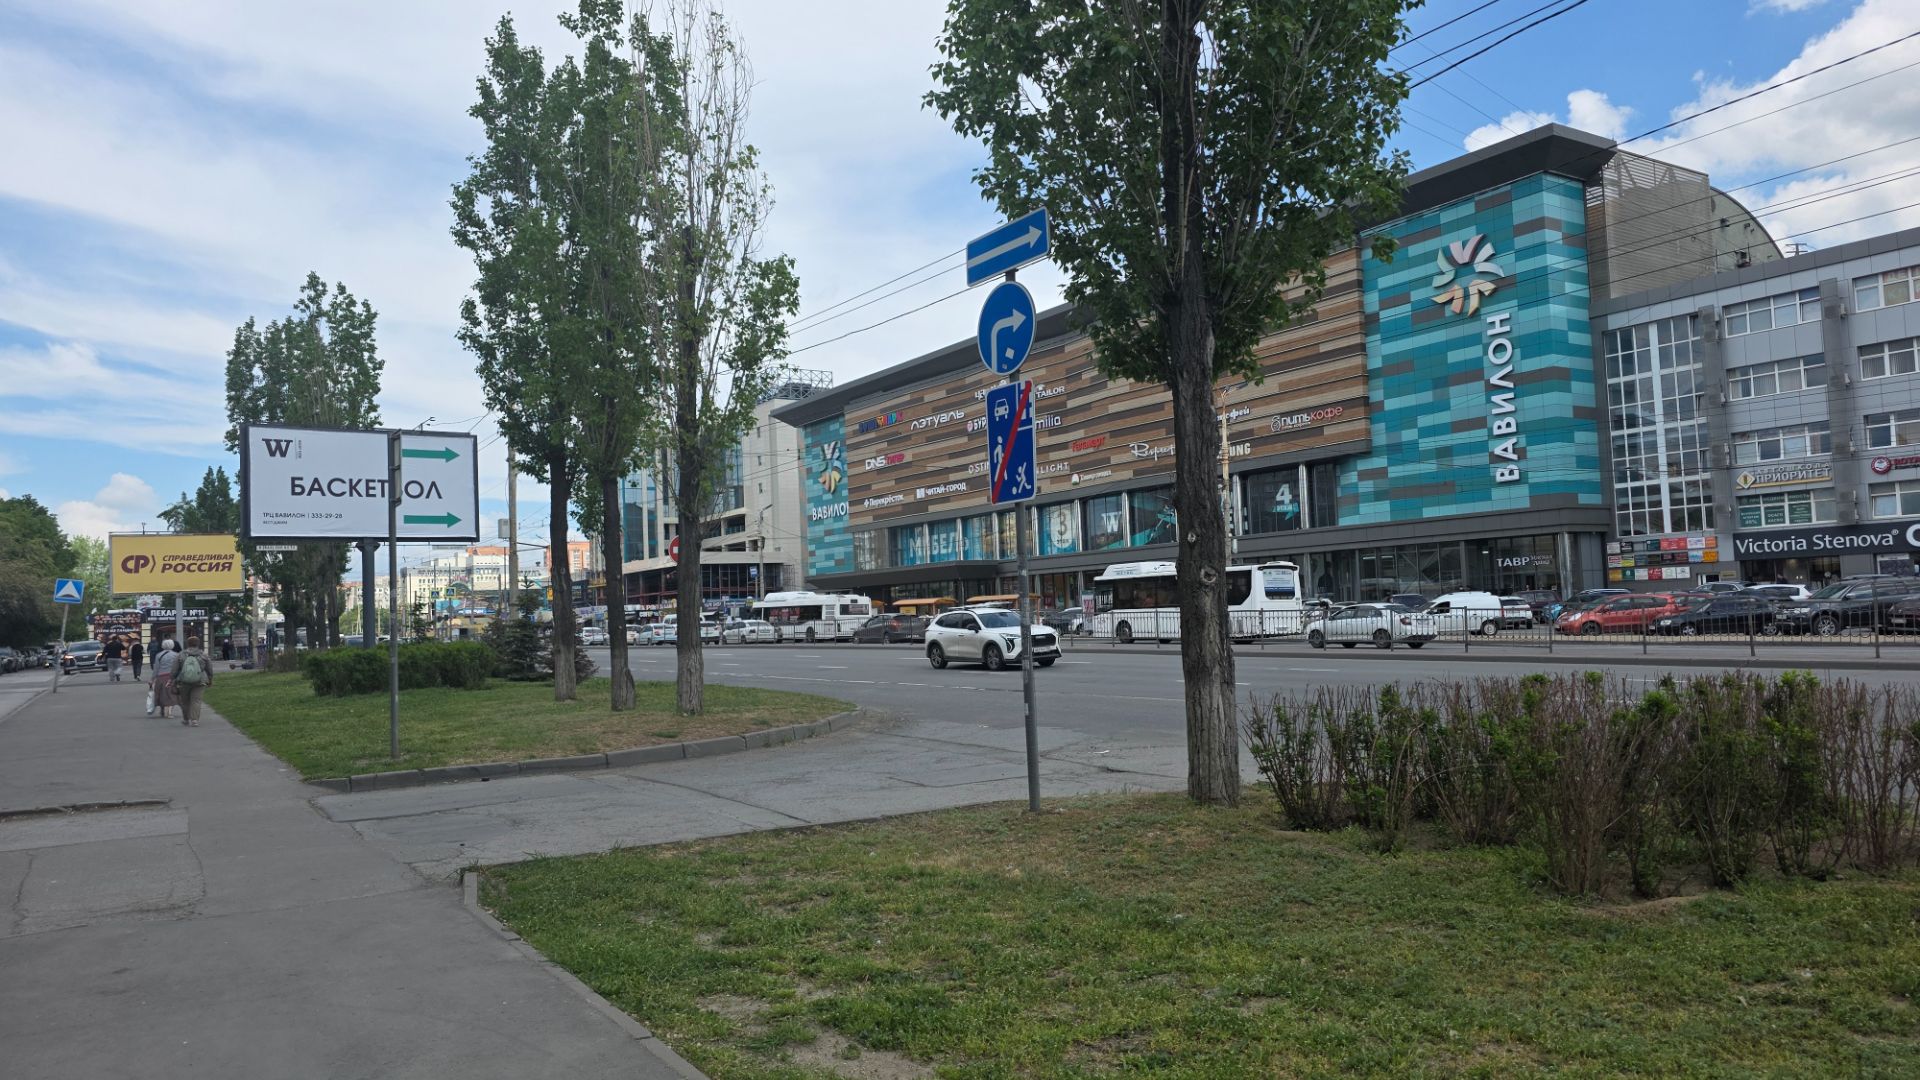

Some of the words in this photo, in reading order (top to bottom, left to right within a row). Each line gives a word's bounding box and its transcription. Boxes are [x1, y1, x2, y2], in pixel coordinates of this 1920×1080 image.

[1486, 312, 1521, 482] ВАВИЛОН
[1035, 415, 1062, 429] milia
[261, 438, 294, 458] W
[865, 455, 886, 470] DNS
[1756, 468, 1831, 482] ПРИОРИТЕТ
[290, 476, 443, 500] БАСКЕТОЛ
[926, 482, 967, 496] ЧИТАЙ-ГОРОД
[1276, 483, 1293, 505] 4
[1057, 511, 1068, 536] 3
[1735, 535, 1807, 554] Victoria
[121, 554, 150, 574] СР
[162, 553, 234, 563] СПРАВЕДЛИВАЯ
[1496, 556, 1530, 568] ТАВР
[160, 562, 233, 574] РОССИЯ
[150, 609, 187, 617] ПЕКАРЯ
